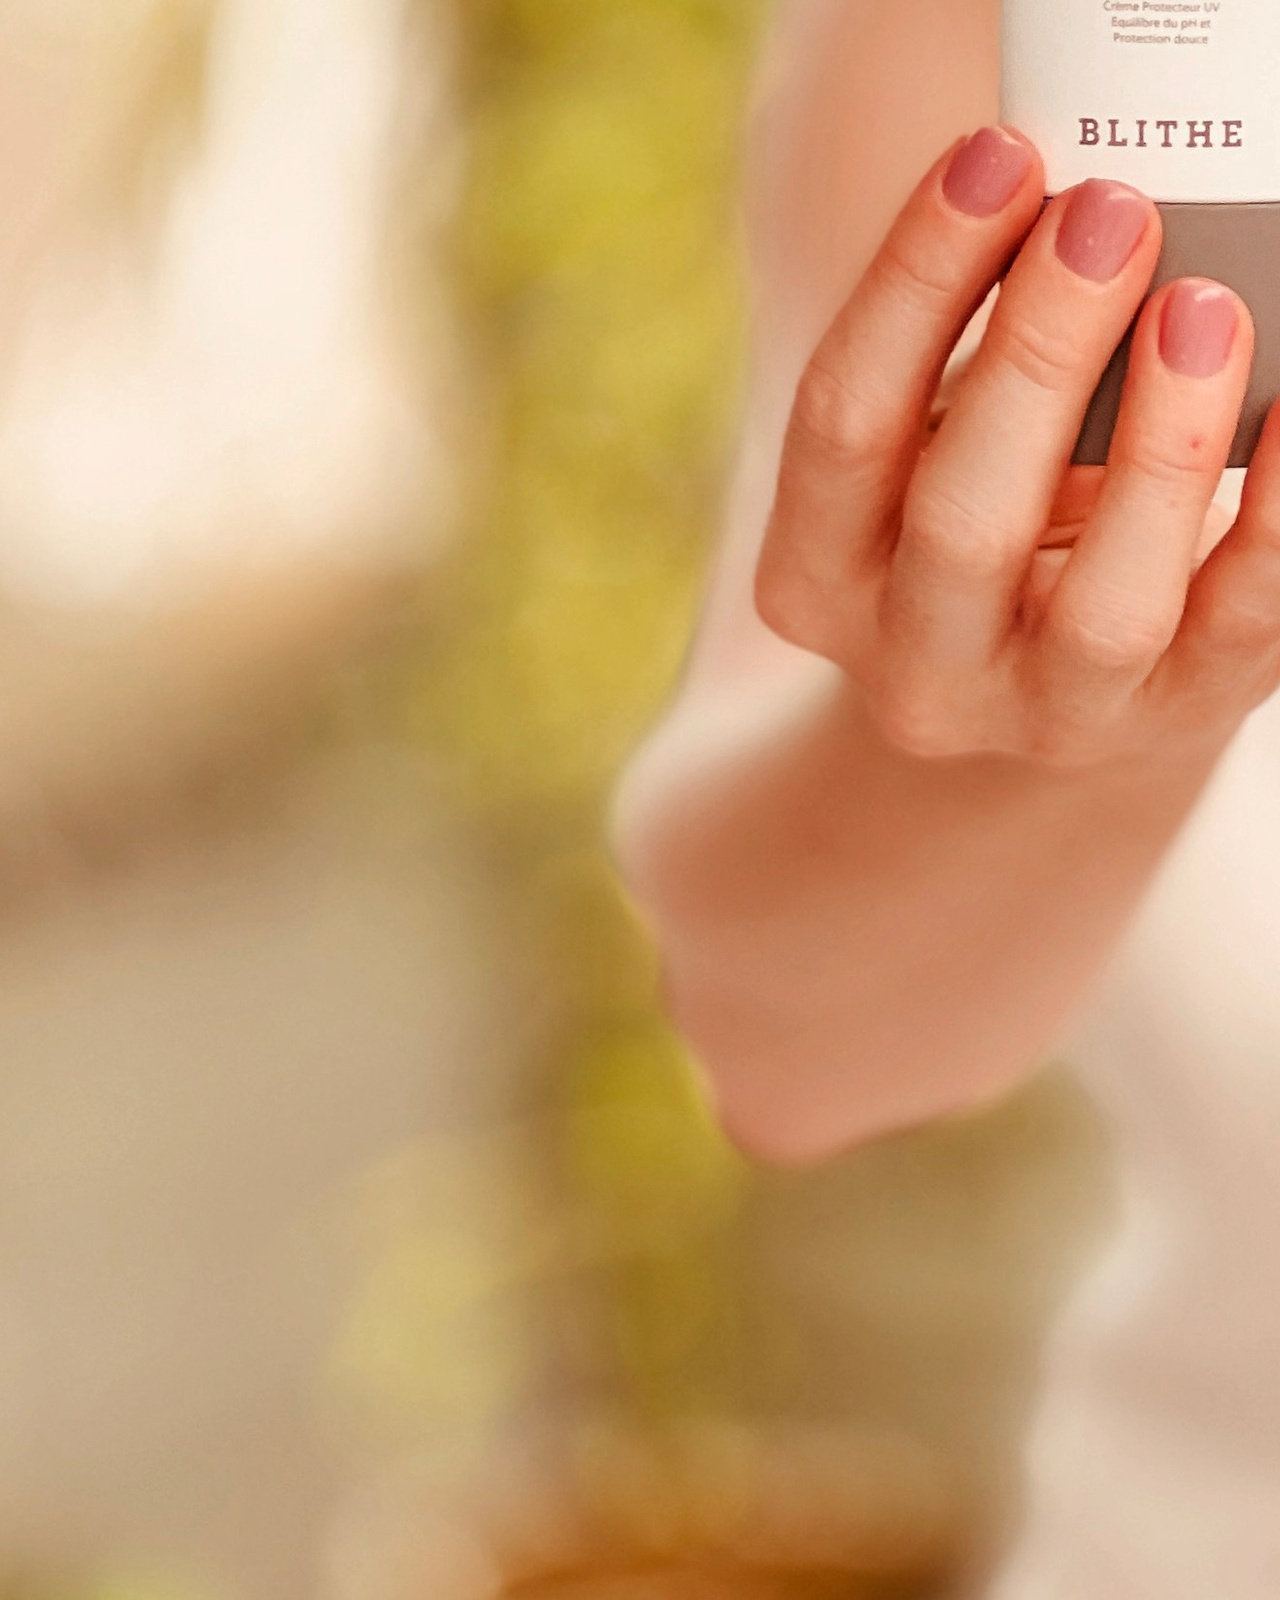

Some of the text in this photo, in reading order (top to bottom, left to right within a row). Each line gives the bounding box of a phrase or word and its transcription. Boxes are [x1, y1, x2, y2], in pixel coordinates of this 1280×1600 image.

[1142, 1, 1201, 13] Protecteur
[1203, 2, 1221, 13] UV
[1163, 18, 1178, 29] du
[1200, 19, 1211, 29] et
[1113, 32, 1209, 45] Protection douce
[1077, 117, 1243, 148] BLITHE
